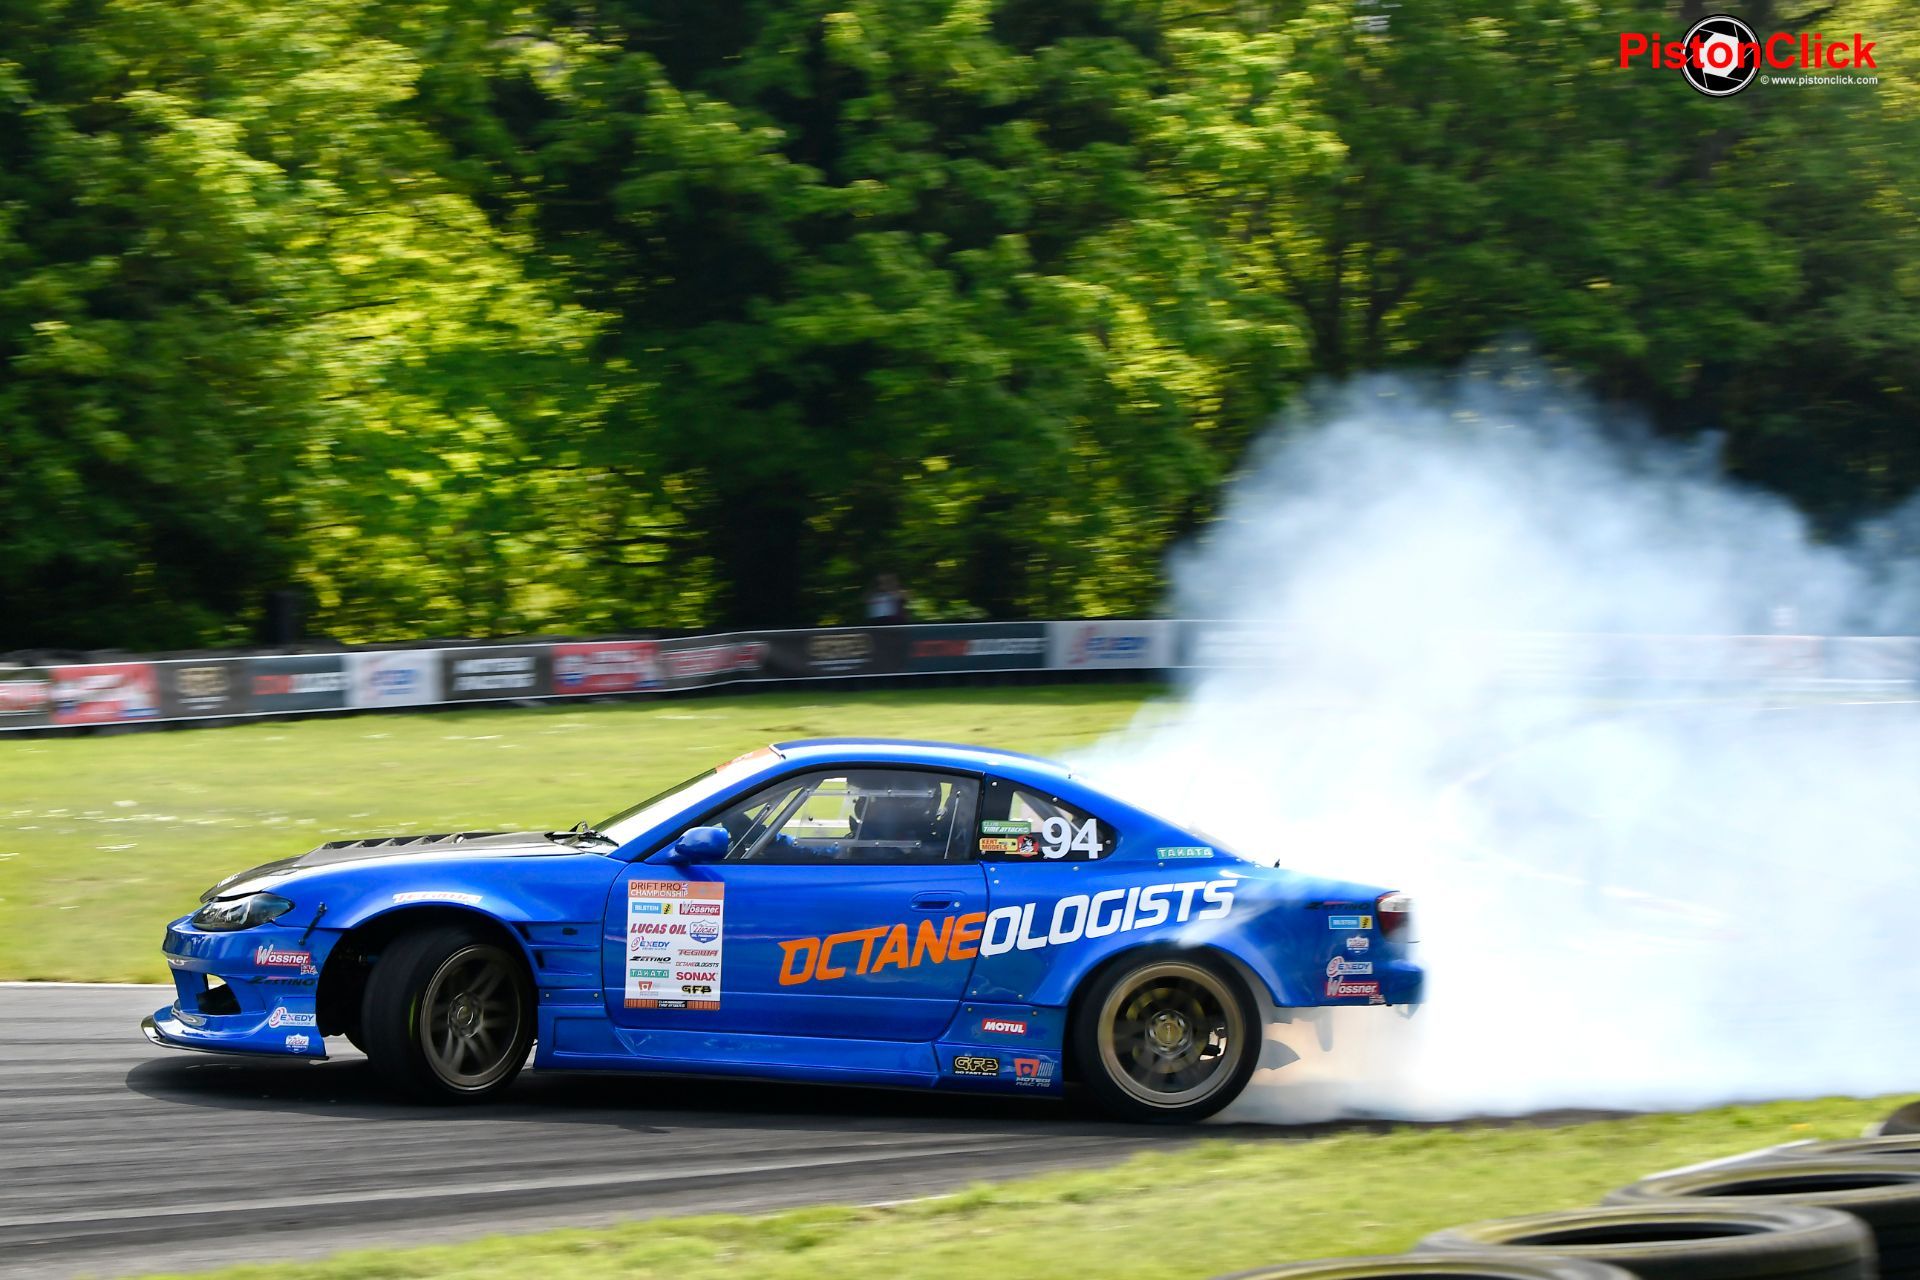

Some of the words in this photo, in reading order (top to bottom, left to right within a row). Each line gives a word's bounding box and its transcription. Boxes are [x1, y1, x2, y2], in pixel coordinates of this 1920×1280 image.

[1041, 816, 1103, 859] 94
[1159, 848, 1213, 858] TAKATA
[630, 882, 659, 890] DRIFT
[660, 882, 681, 891] PRO
[630, 889, 688, 897] CHAMPIONSHIP
[630, 923, 667, 934] LUCAS
[669, 924, 687, 934] OIL
[630, 969, 669, 977] TAKATA
[676, 971, 716, 981] SONAX
[280, 1014, 314, 1022] EXEDY
[984, 1021, 1024, 1033] MOTUL
[954, 1056, 999, 1071] GFB
